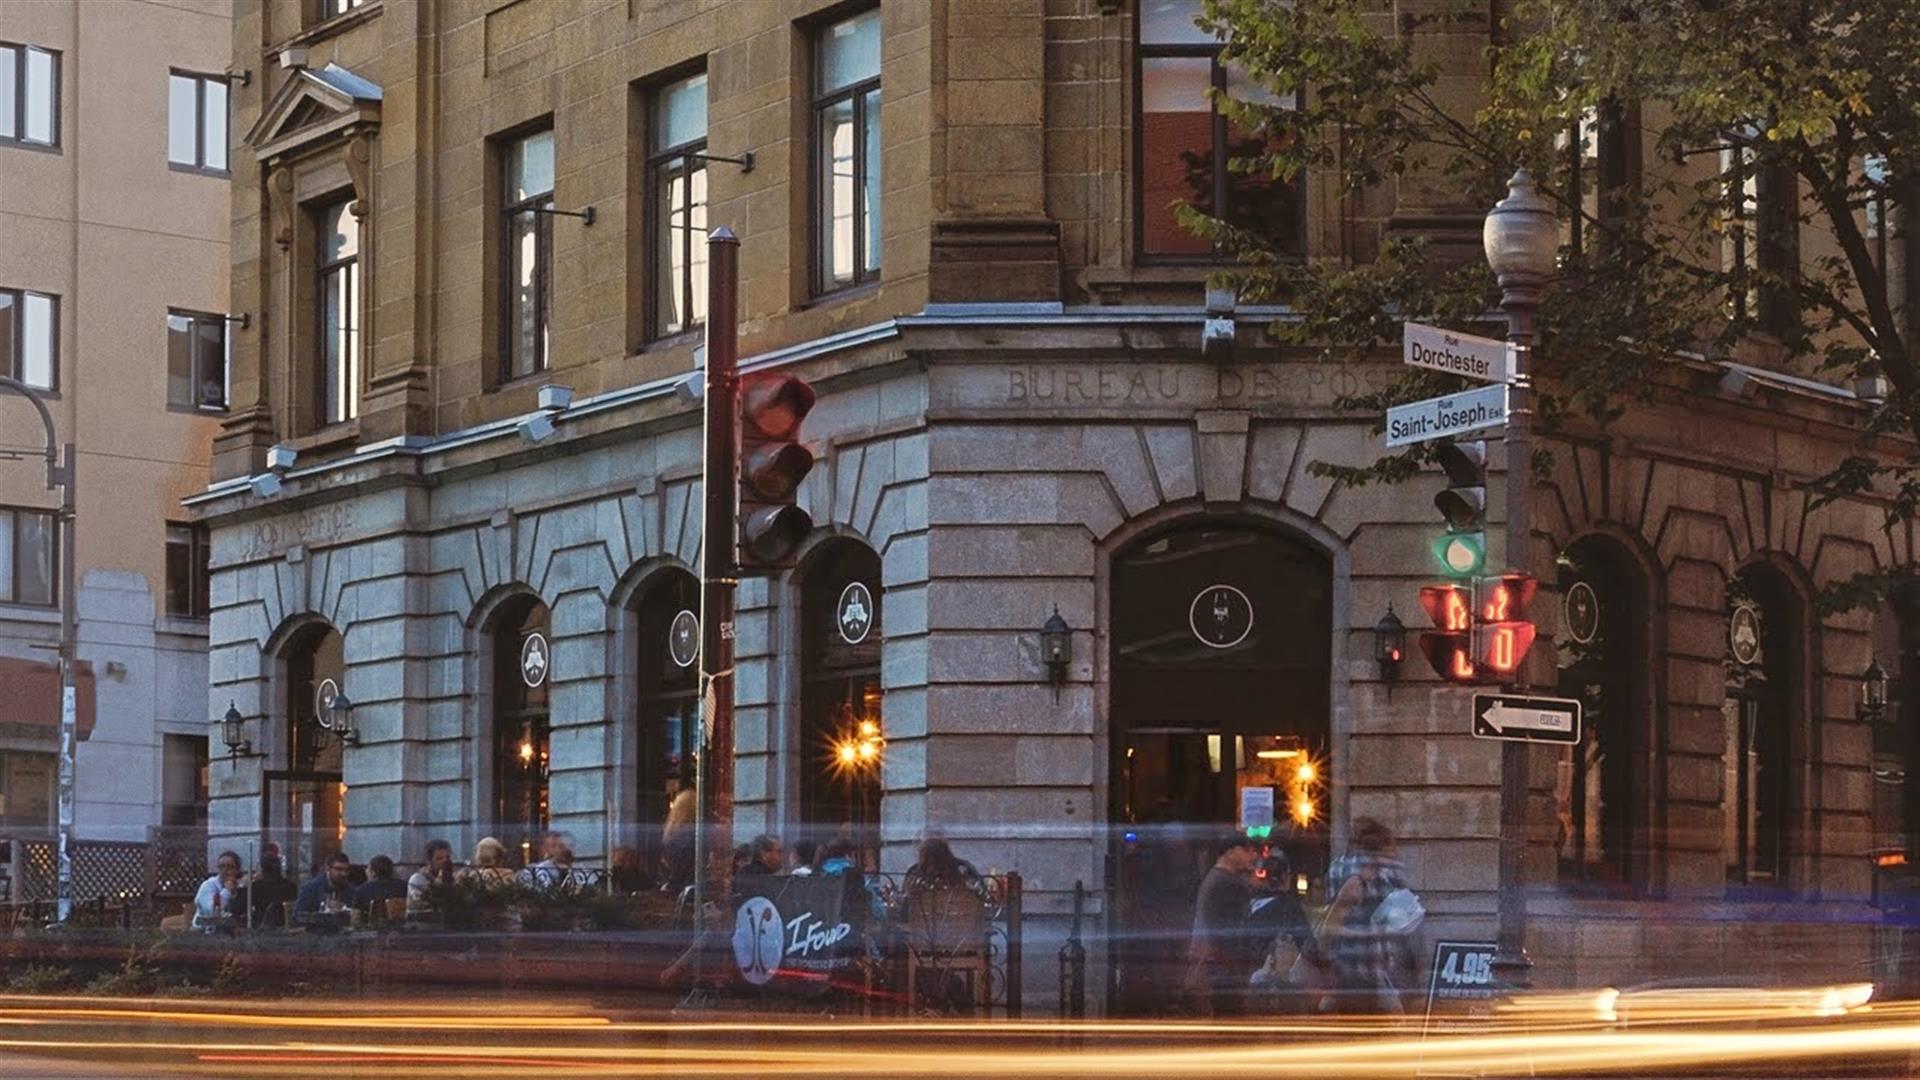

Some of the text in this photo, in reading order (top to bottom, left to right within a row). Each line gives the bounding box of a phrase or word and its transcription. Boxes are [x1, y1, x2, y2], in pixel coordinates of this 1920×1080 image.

[1444, 334, 1459, 347] Rue
[1411, 341, 1490, 375] Dorchester
[1008, 369, 1181, 400] BUREAU
[1217, 369, 1279, 399] DE
[1391, 403, 1486, 439] Saint-Joseph
[1438, 400, 1454, 411] Rue
